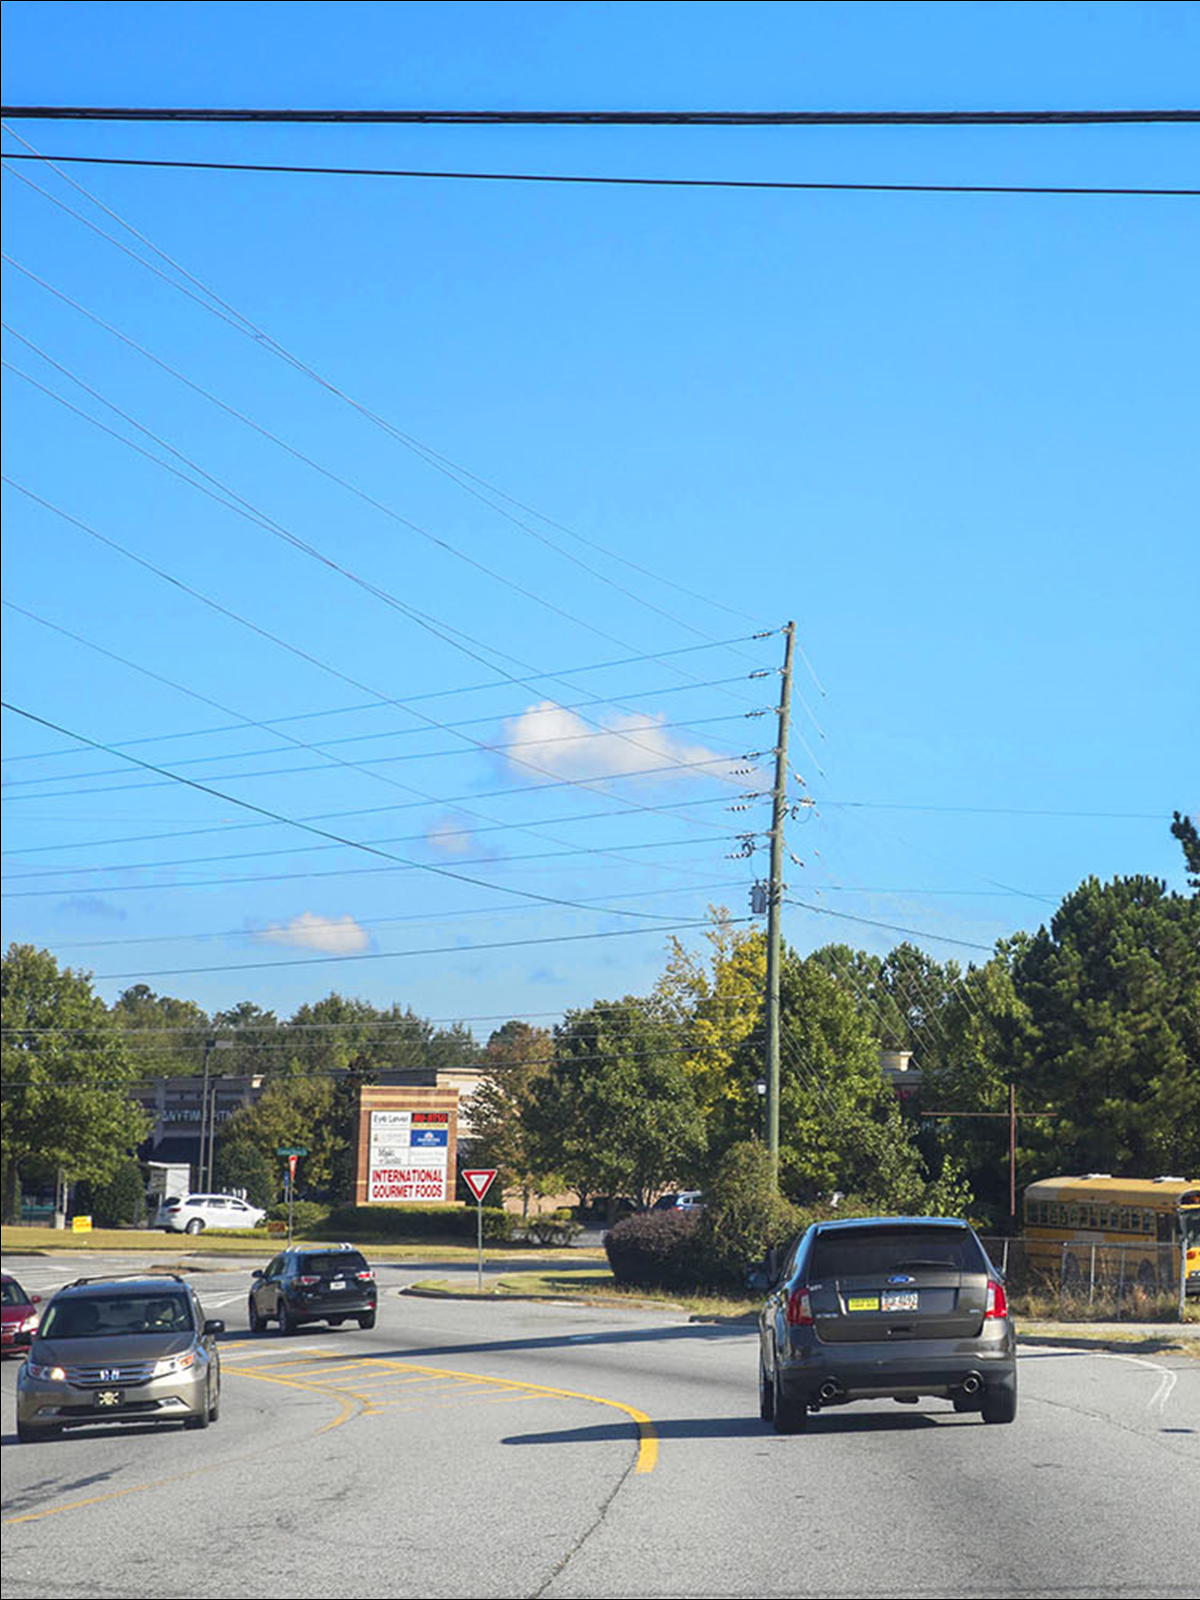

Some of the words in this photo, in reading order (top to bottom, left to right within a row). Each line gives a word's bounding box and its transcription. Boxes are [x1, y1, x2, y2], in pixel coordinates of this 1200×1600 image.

[372, 1168, 444, 1183] INTERNATIONAL
[372, 1184, 413, 1199] GOURMET
[415, 1184, 443, 1198] FOODS
